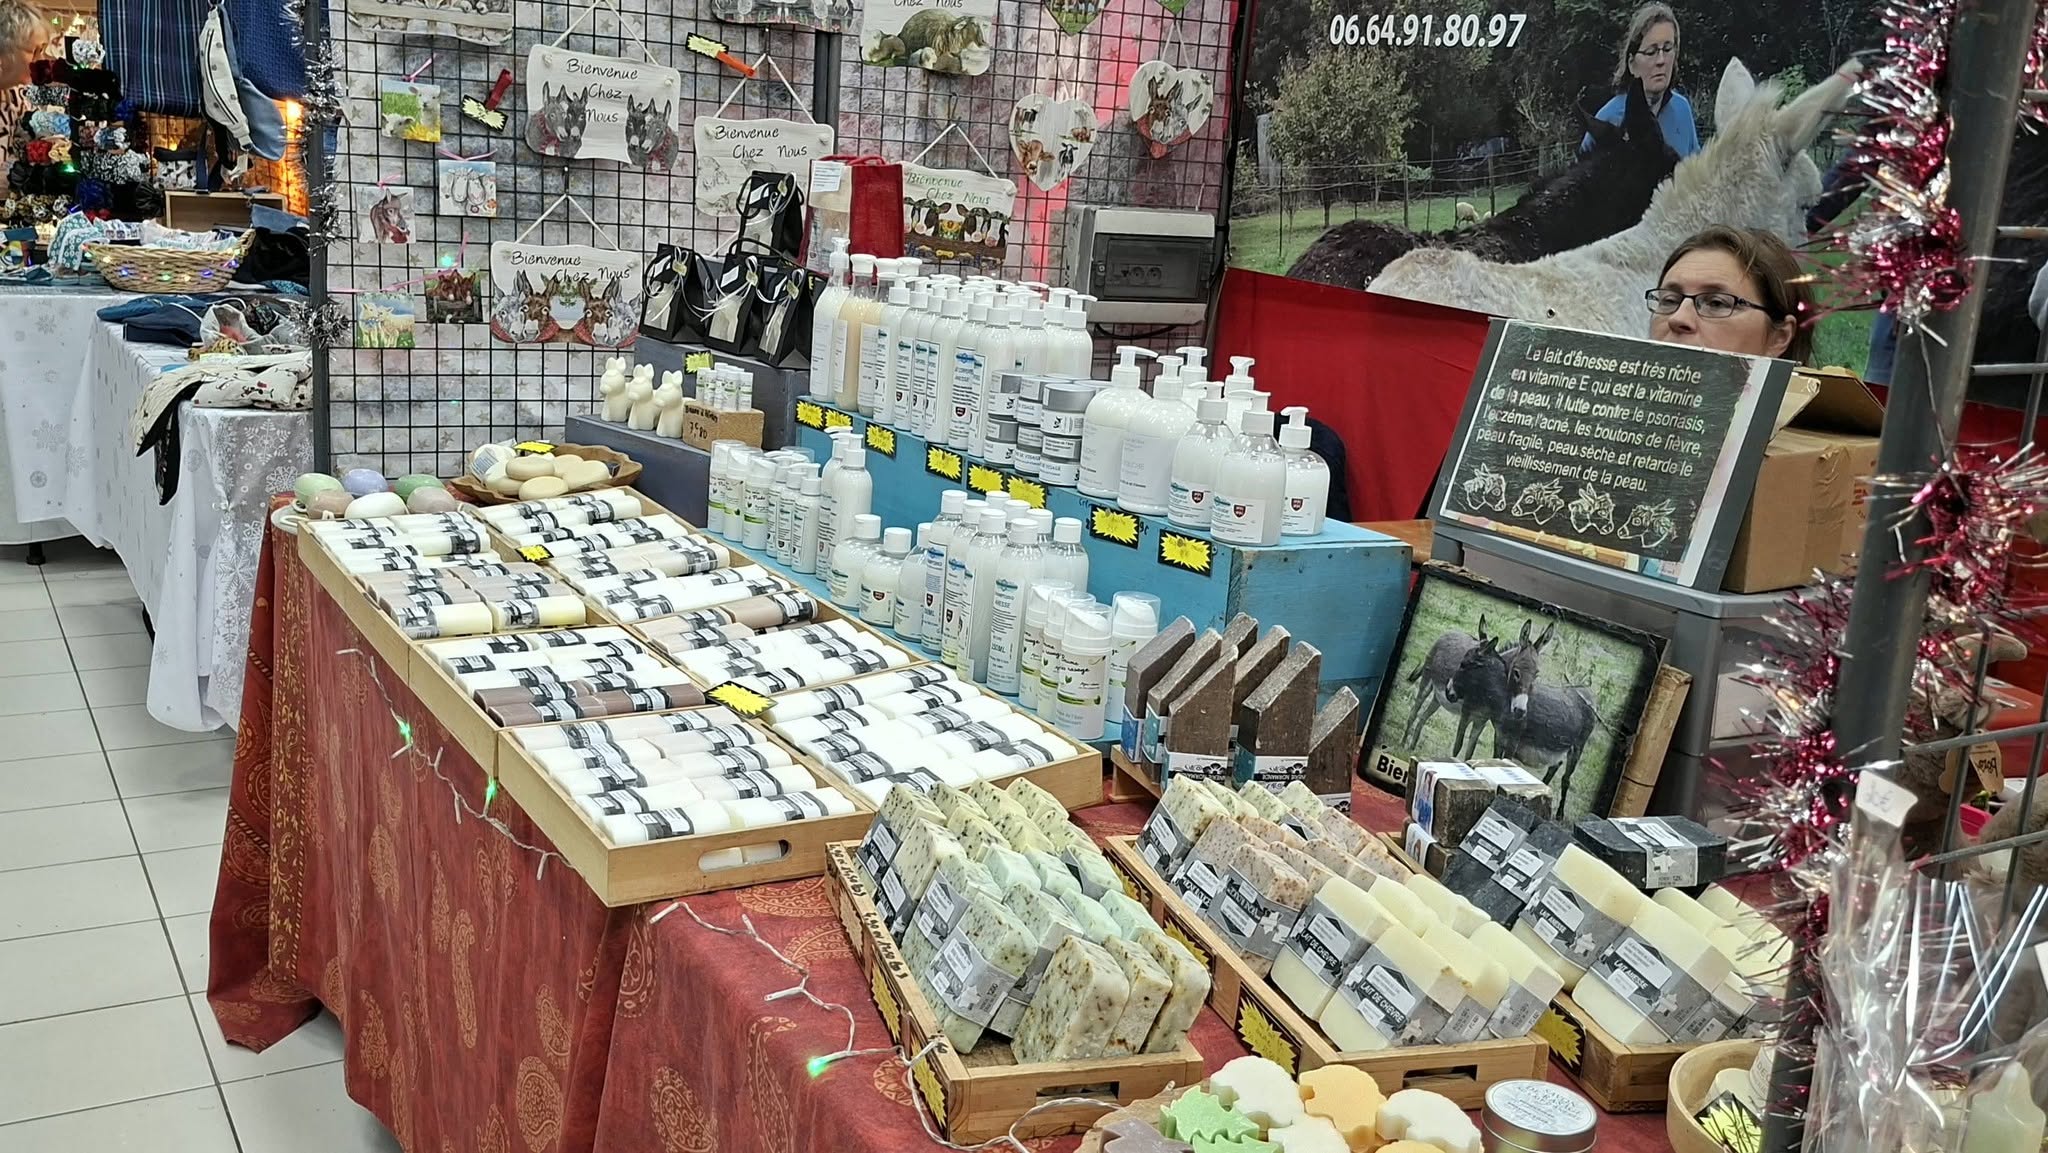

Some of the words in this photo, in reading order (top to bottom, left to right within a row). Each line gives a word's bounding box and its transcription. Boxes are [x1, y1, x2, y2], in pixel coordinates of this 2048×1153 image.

[1329, 13, 1528, 48] 06.64.91.80.97
[566, 58, 638, 80] Bienvenue
[588, 82, 622, 99] Chez
[584, 108, 619, 123] Nous
[714, 125, 779, 140] Bienvenue
[732, 144, 763, 159] Chez
[777, 144, 808, 158] Nous
[907, 172, 965, 188] Bienvenue
[926, 187, 954, 200] Chez
[963, 192, 991, 205] Nous
[510, 250, 582, 266] Bienvenue
[554, 268, 590, 283] Chez
[597, 266, 631, 280] Nous
[1524, 344, 1540, 361] Le
[1542, 346, 1562, 364] lait
[1563, 349, 1618, 373] d'ânesse
[1618, 357, 1641, 375] est
[1640, 360, 1665, 380] très
[1667, 362, 1701, 385] riche
[1510, 367, 1526, 382] en
[1527, 369, 1577, 390] vitamine
[1578, 374, 1590, 392] E
[1590, 377, 1611, 397] qui
[1612, 381, 1635, 398] est
[1634, 382, 1647, 399] la
[1649, 383, 1704, 409] vitamine
[1489, 383, 1505, 400] de
[1506, 386, 1519, 403] la
[1518, 389, 1551, 411] peau,
[1554, 391, 1564, 409] il
[1563, 394, 1591, 415] lutte
[1591, 398, 1631, 421] contre
[1631, 403, 1644, 422] le
[1646, 408, 1706, 435] psoriasis,
[1573, 418, 1592, 437] les
[1594, 424, 1644, 447] boutons
[1645, 431, 1662, 449] de
[1475, 425, 1507, 444] peau
[1507, 430, 1544, 452] fragile,
[1548, 438, 1579, 458] peau
[1579, 442, 1616, 465] sèche
[1616, 448, 1632, 466] et
[1632, 449, 1679, 474] retarde
[1679, 459, 1693, 477] le
[1505, 452, 1582, 480] vieillissement
[1582, 463, 1598, 482] de
[1600, 467, 1613, 485] la
[1613, 471, 1648, 493] peau.
[1300, 929, 1312, 943] LAIT
[1309, 940, 1317, 950] DE
[1316, 945, 1338, 968] CHEVRE
[1360, 981, 1374, 997] LAIT
[1371, 992, 1381, 1004] DE
[1379, 998, 1405, 1024] CHEVRE
